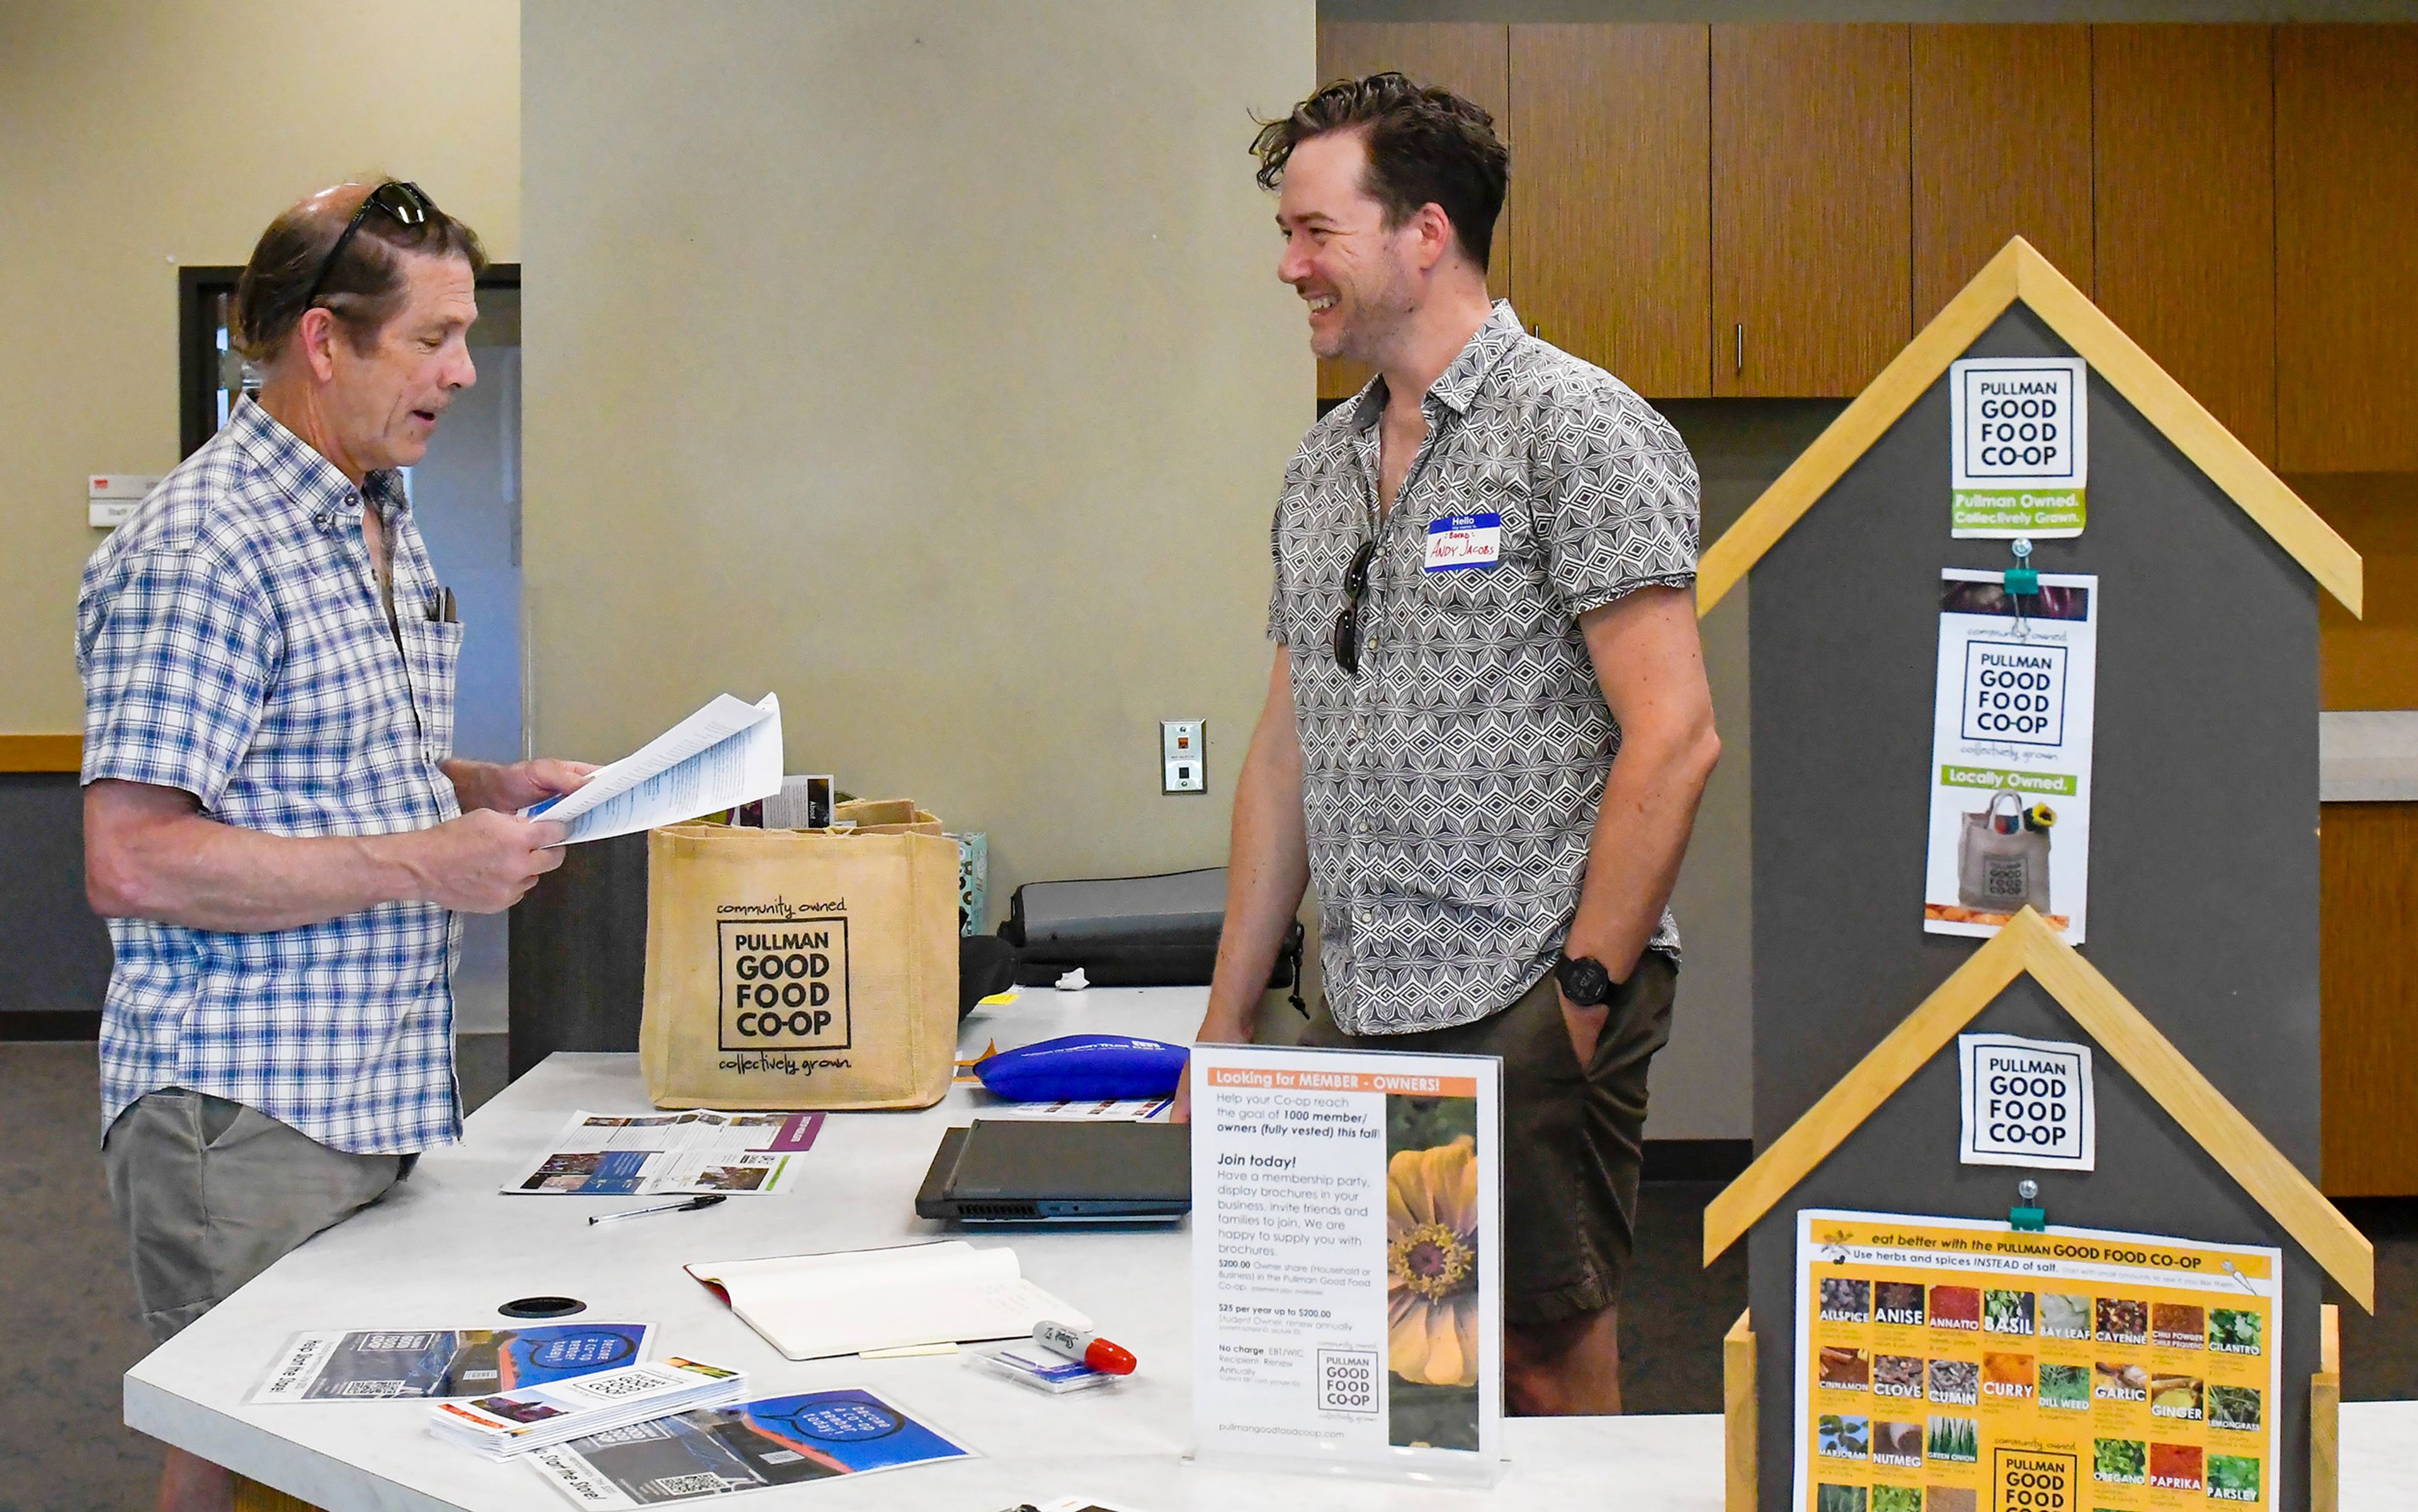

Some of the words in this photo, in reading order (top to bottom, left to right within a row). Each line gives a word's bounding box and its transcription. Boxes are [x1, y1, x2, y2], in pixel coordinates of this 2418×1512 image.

[1981, 382, 2057, 395] PULLMAN
[1981, 399, 2057, 418] GOOD
[1981, 423, 2057, 441] FOOD
[1981, 446, 2057, 465] CO-OP
[1955, 494, 2016, 508] Pullman
[2020, 494, 2079, 508] Owned.
[1452, 516, 1475, 526] Hello
[1954, 511, 2031, 525] Collectively
[2035, 511, 2079, 524] Grown.
[1980, 653, 2052, 669] PULLMAN
[1980, 670, 2050, 691] GOOD
[1978, 691, 2050, 712] FOOD
[1977, 712, 2048, 734] CO-OP
[1950, 768, 2004, 787] Locally
[2007, 773, 2067, 790] Owned.
[717, 895, 796, 919] community
[735, 932, 829, 951] PULLMAN
[735, 953, 830, 980] GOOD
[736, 982, 830, 1008] FOOD
[736, 1009, 832, 1037] CO-OP
[718, 1050, 798, 1075] collectively
[1989, 1058, 2066, 1076] PULLMAN
[1216, 1070, 1273, 1089] Looking
[1276, 1072, 1296, 1085] for
[1299, 1073, 1359, 1088] MEMBER
[1373, 1075, 1440, 1092] OWNERS!
[1990, 1076, 2066, 1098] GOOD
[1217, 1093, 1242, 1105] Help
[1246, 1096, 1270, 1106] your
[1274, 1094, 1312, 1108] Co-op
[1314, 1098, 1349, 1108] reach
[1217, 1108, 1235, 1117] the
[1239, 1109, 1265, 1120] goal
[1268, 1110, 1280, 1119] of
[1283, 1110, 1309, 1120] 1000
[1312, 1113, 1368, 1123] member/
[1990, 1100, 2066, 1122] FOOD
[1217, 1124, 1257, 1133] owners
[1261, 1123, 1288, 1137] (fully
[1292, 1127, 1334, 1139] vested)
[1337, 1128, 1356, 1137] this
[1989, 1123, 2066, 1145] CO-OP
[1217, 1153, 1246, 1166] Join
[1249, 1154, 1297, 1170] today!
[1217, 1170, 1247, 1181] Have
[1251, 1174, 1259, 1182] a
[1262, 1173, 1334, 1186] membership
[1217, 1185, 1257, 1198] display
[1260, 1187, 1318, 1199] brochures
[1320, 1190, 1331, 1200] in
[1334, 1192, 1359, 1202] your
[1269, 1203, 1300, 1214] invite
[1303, 1204, 1341, 1215] friends
[1344, 1206, 1368, 1217] and
[1218, 1214, 1260, 1225] families
[1263, 1216, 1275, 1226] to
[1304, 1219, 1323, 1229] We
[1325, 1221, 1346, 1230] are
[1218, 1229, 1256, 1241] happy
[1259, 1231, 1271, 1241] to
[1273, 1234, 1310, 1246] supply
[1314, 1236, 1336, 1246] you
[1338, 1236, 1362, 1246] with
[1218, 1244, 1278, 1256] brochures.
[1871, 1234, 1894, 1245] eat
[1897, 1234, 1938, 1248] better
[1941, 1239, 1968, 1249] with
[1972, 1240, 1993, 1251] the
[1997, 1242, 2051, 1255] PULLMAN
[2053, 1244, 2100, 1259] GOOD
[2104, 1249, 2147, 1264] FOOD
[2150, 1254, 2202, 1268] CO-OP
[1218, 1260, 1251, 1269] $200.00
[1853, 1250, 1873, 1259] Use
[1876, 1251, 1907, 1262] herbs
[1910, 1253, 1932, 1263] and
[1935, 1256, 1971, 1266] spices
[1973, 1258, 2019, 1270] INSTEAD
[2022, 1261, 2033, 1270] of
[1218, 1303, 1234, 1312] $25
[1235, 1305, 1250, 1314] per
[1252, 1307, 1272, 1316] year
[1274, 1308, 1286, 1316] up
[1288, 1307, 1297, 1316] to
[1298, 1308, 1331, 1318] $200.00
[1820, 1310, 1869, 1322] ALLSPICE
[1875, 1307, 1923, 1324] ANISE
[1929, 1317, 1979, 1331] ANNATTO
[1984, 1316, 2033, 1334] BASIL
[2040, 1326, 2063, 1337] BAY
[2065, 1327, 2091, 1339] LEAF
[2095, 1331, 2147, 1344] CAYENNE
[2172, 1332, 2204, 1341] POWDER
[1219, 1344, 1232, 1353] No
[1233, 1345, 1264, 1356] charge
[2209, 1341, 2260, 1355] CILANTRO
[1326, 1356, 1370, 1367] PULLMAN
[1219, 1365, 1256, 1377] Annually
[1326, 1367, 1370, 1379] GOOD
[1327, 1380, 1370, 1392] FOOD
[1819, 1380, 1869, 1391] CINNAMON
[1873, 1383, 1922, 1398] CLOVE
[1983, 1381, 2033, 1398] CURRY
[1327, 1392, 1370, 1406] CO-OP
[1929, 1390, 1977, 1405] CUMIN
[2094, 1387, 2146, 1401] GARLIC
[2038, 1397, 2058, 1407] DILL
[2060, 1399, 2089, 1410] WEED
[2151, 1405, 2202, 1419] GINGER
[1218, 1423, 1345, 1438] pullmangoodfoodcoop.com
[2208, 1419, 2260, 1431] LEMONGRASS
[1994, 1438, 2043, 1452] community
[1819, 1448, 1868, 1460] MARJORAM
[1873, 1453, 1921, 1467] NUTMEG
[1927, 1452, 1950, 1460] GREEN
[1951, 1453, 1976, 1462] ONION
[2006, 1458, 2065, 1473] PULLMAN
[2006, 1472, 2065, 1490] GOOD
[2093, 1471, 2145, 1485] OREGANO
[2150, 1475, 2202, 1490] PAPRIKA
[2006, 1489, 2065, 1508] FOOD
[2206, 1487, 2257, 1501] PARSLEY
